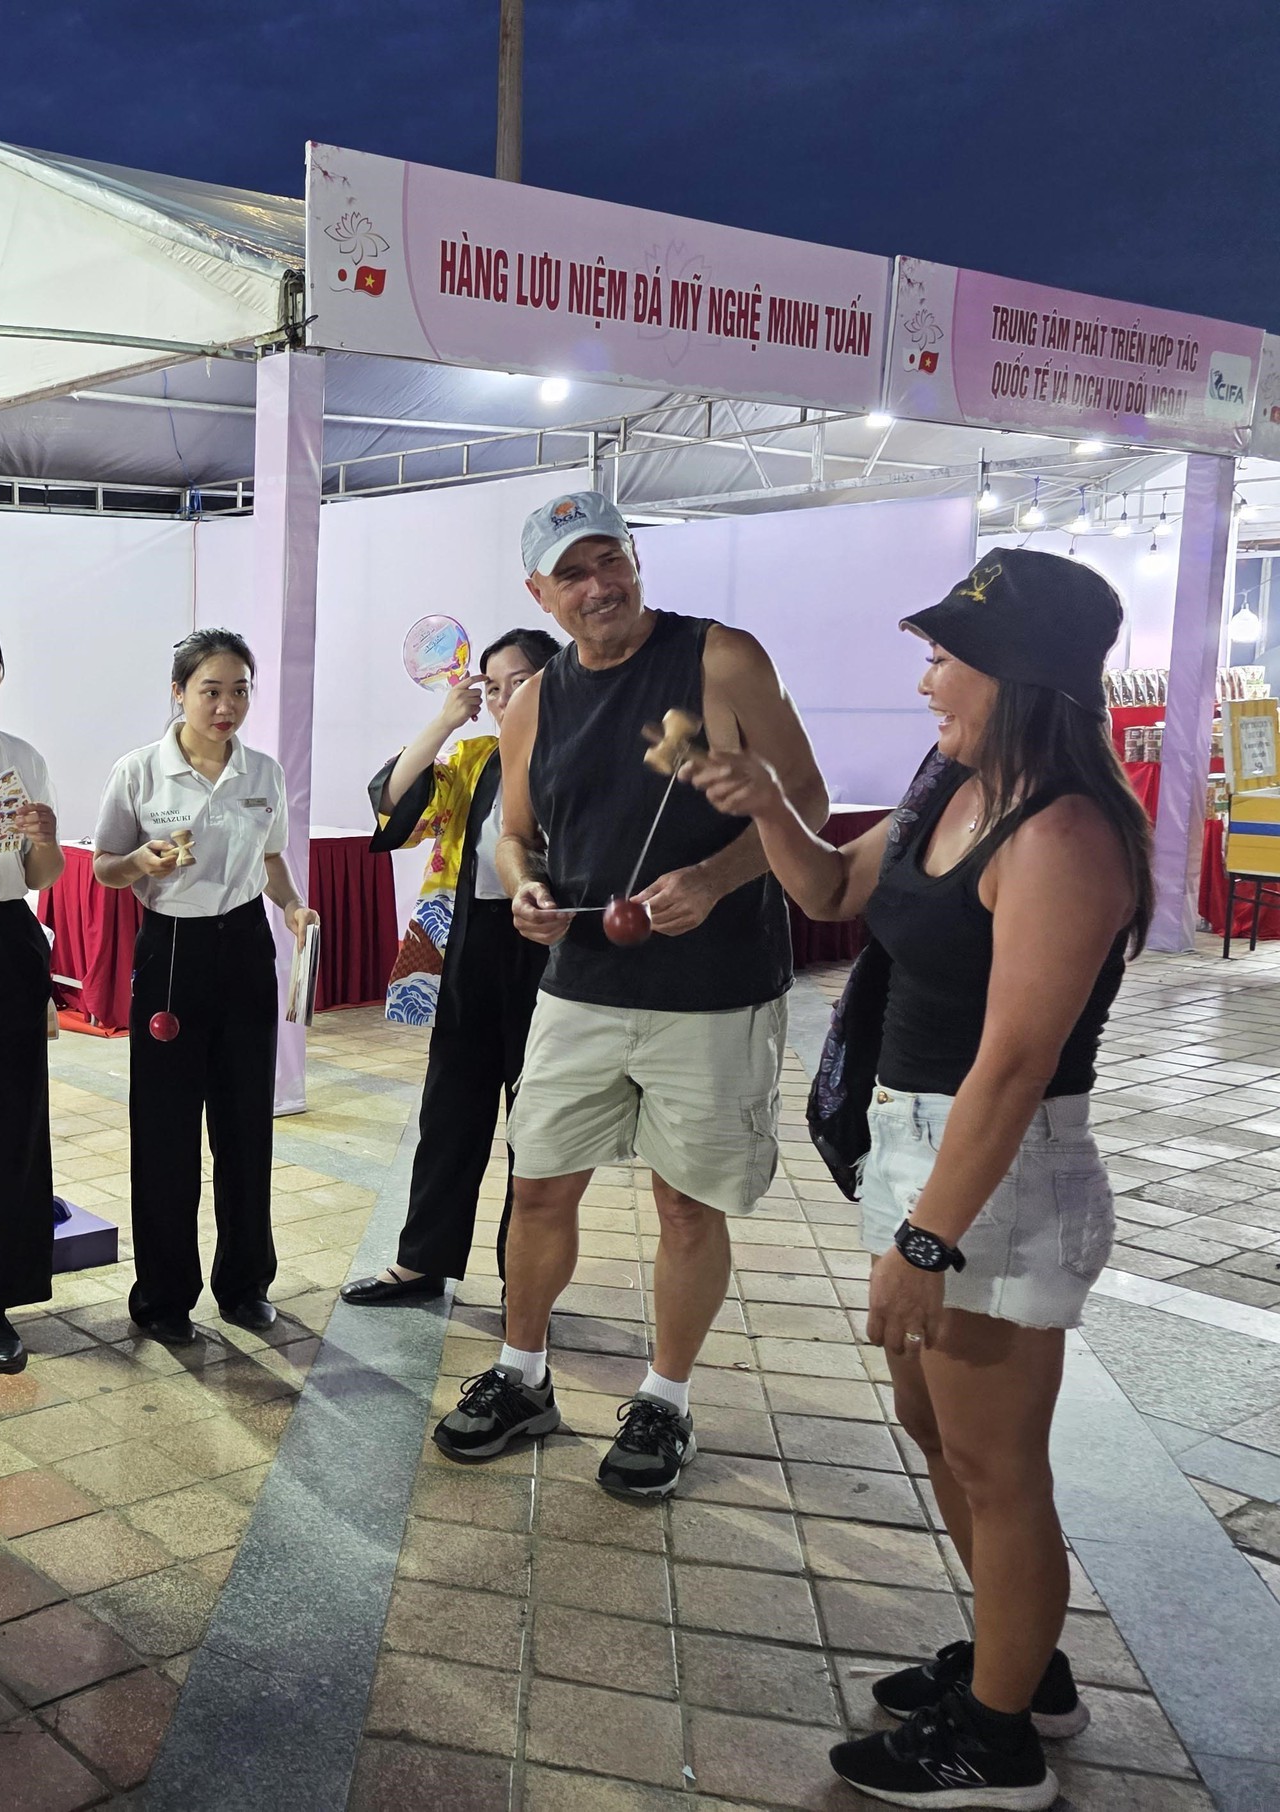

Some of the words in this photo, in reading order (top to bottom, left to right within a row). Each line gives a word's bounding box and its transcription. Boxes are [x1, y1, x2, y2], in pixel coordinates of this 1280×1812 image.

[440, 231, 508, 304] HÀNG
[516, 252, 560, 312] LƯU
[568, 255, 628, 330] NIỆM
[632, 266, 663, 327] ĐÁ
[669, 273, 705, 332] MỸ
[707, 284, 762, 352] NGHỆ
[766, 296, 820, 351] MINH
[824, 293, 874, 358] TUẤN
[991, 304, 1038, 347] TRUNG
[1041, 308, 1071, 352] TÂM
[1073, 315, 1108, 357] PHÁT
[1109, 317, 1148, 365] TRIỂN
[1148, 332, 1175, 374] HỢP
[1177, 334, 1199, 373] TÁC
[991, 353, 1029, 400] QUỐC
[1034, 358, 1051, 400] TẾ
[1051, 363, 1069, 404] VÀ
[1071, 372, 1105, 414] DỊCH
[1105, 377, 1124, 420] VỤ
[1124, 371, 1148, 416] ĐỐI
[1217, 383, 1244, 404] CIFA
[152, 815, 191, 825] MIKAZUKI
